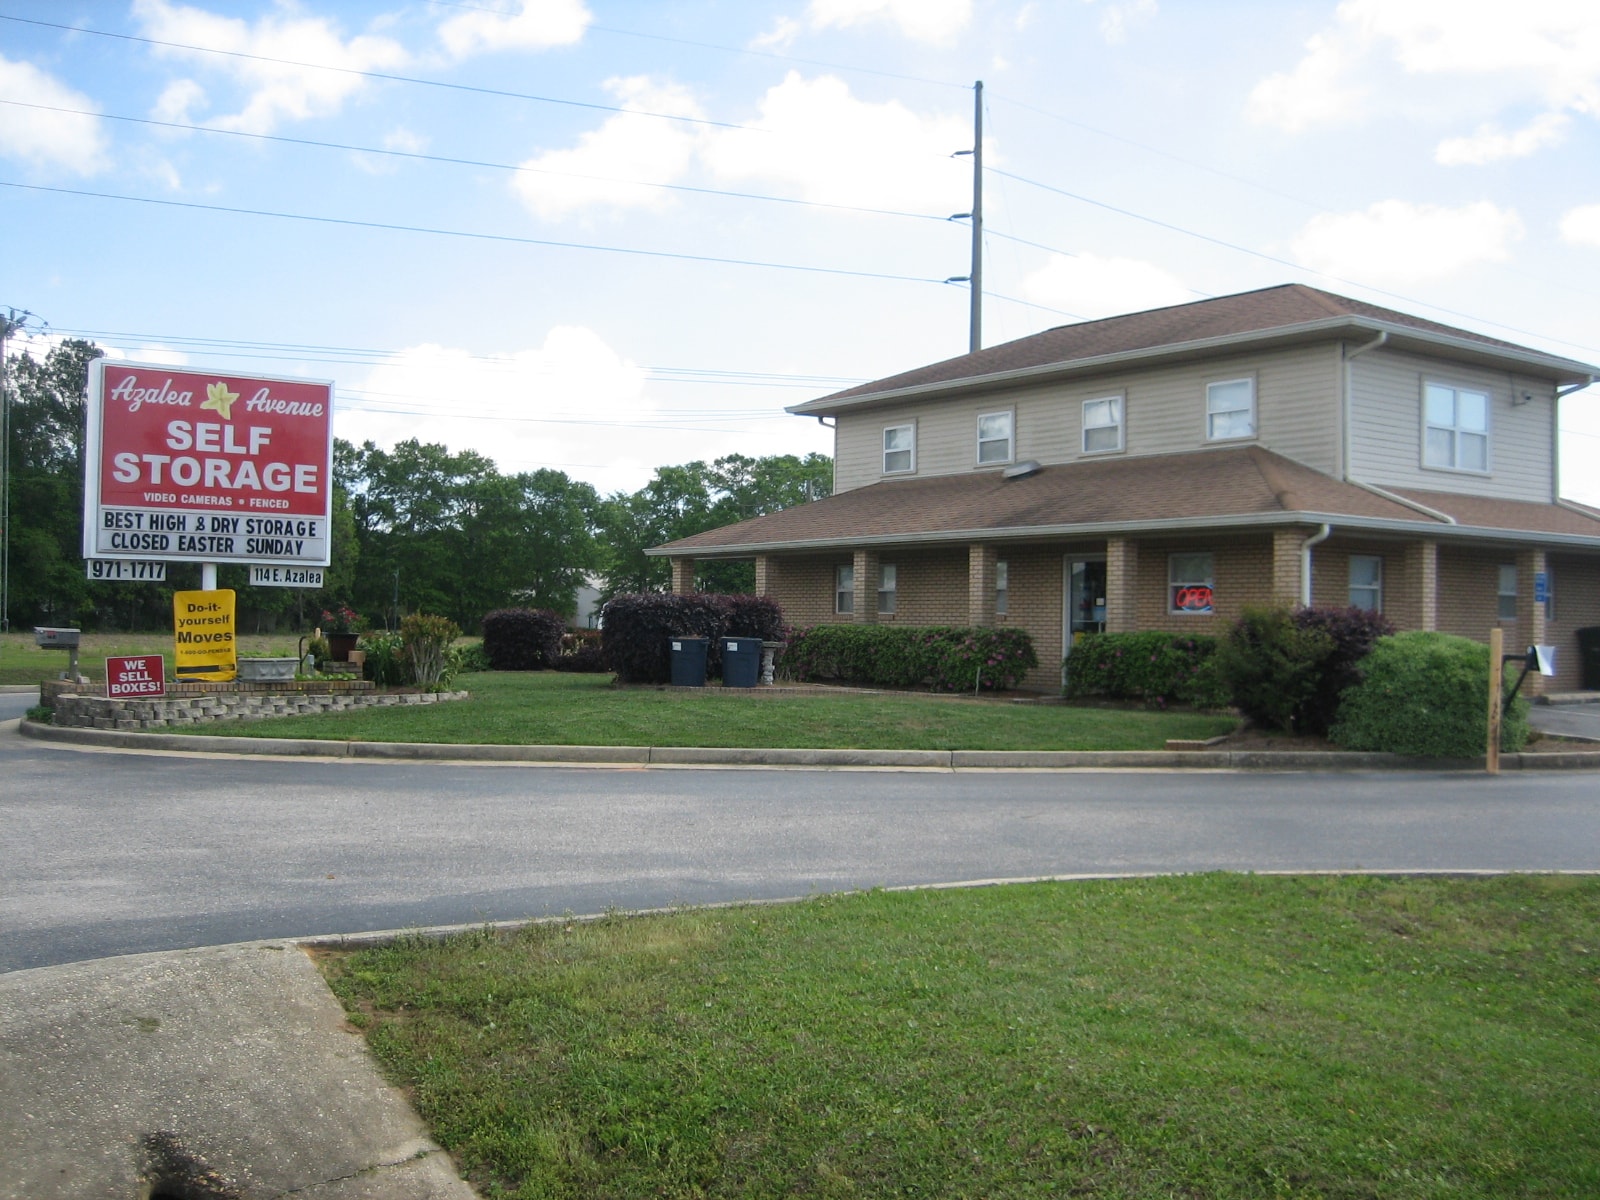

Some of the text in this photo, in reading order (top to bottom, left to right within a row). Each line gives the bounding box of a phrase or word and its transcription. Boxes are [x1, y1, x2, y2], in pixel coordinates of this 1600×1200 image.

[111, 376, 323, 417] Azalea Avenue
[166, 420, 272, 455] SELF
[113, 452, 318, 493] STORAGE
[144, 492, 289, 509] VIDEO CAMERAS FENCED
[104, 511, 316, 536] BEST HIGH & DRY STORAGE
[111, 532, 303, 556] CLOSED EASTER SUNDAY
[92, 561, 164, 578] 971-1717
[255, 567, 321, 583] 114 E. Azalea
[1176, 588, 1214, 608] OPEN
[187, 603, 221, 612] Do-it-
[179, 614, 229, 627] yourself
[177, 631, 232, 643] Moves
[124, 660, 146, 670] WE
[119, 671, 152, 682] SELL
[112, 682, 160, 694] BOXES!
